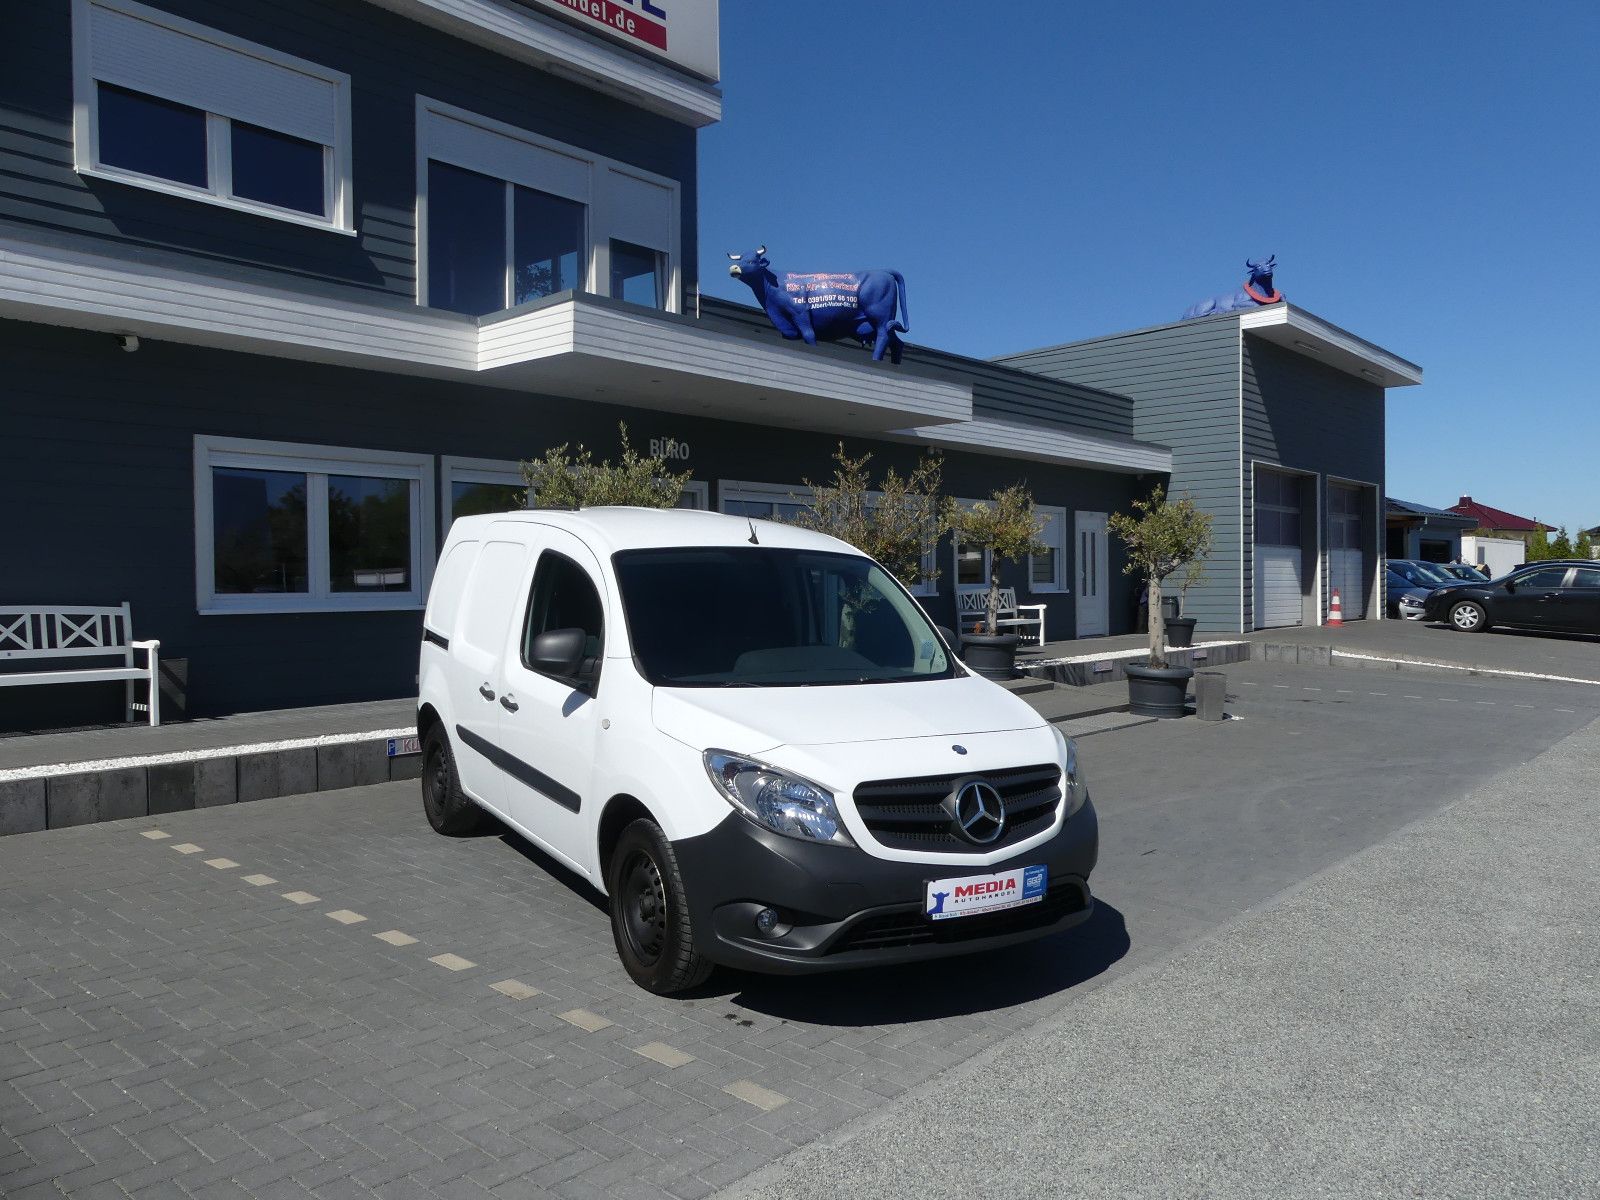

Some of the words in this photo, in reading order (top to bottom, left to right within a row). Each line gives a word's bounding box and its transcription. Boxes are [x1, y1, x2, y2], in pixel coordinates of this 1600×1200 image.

[560, 0, 635, 33] ndel.de
[650, 436, 690, 460] BÜRO
[389, 743, 395, 752] P
[954, 878, 1016, 897] MEDIA
[954, 890, 1015, 903] AUTOHANDEL
